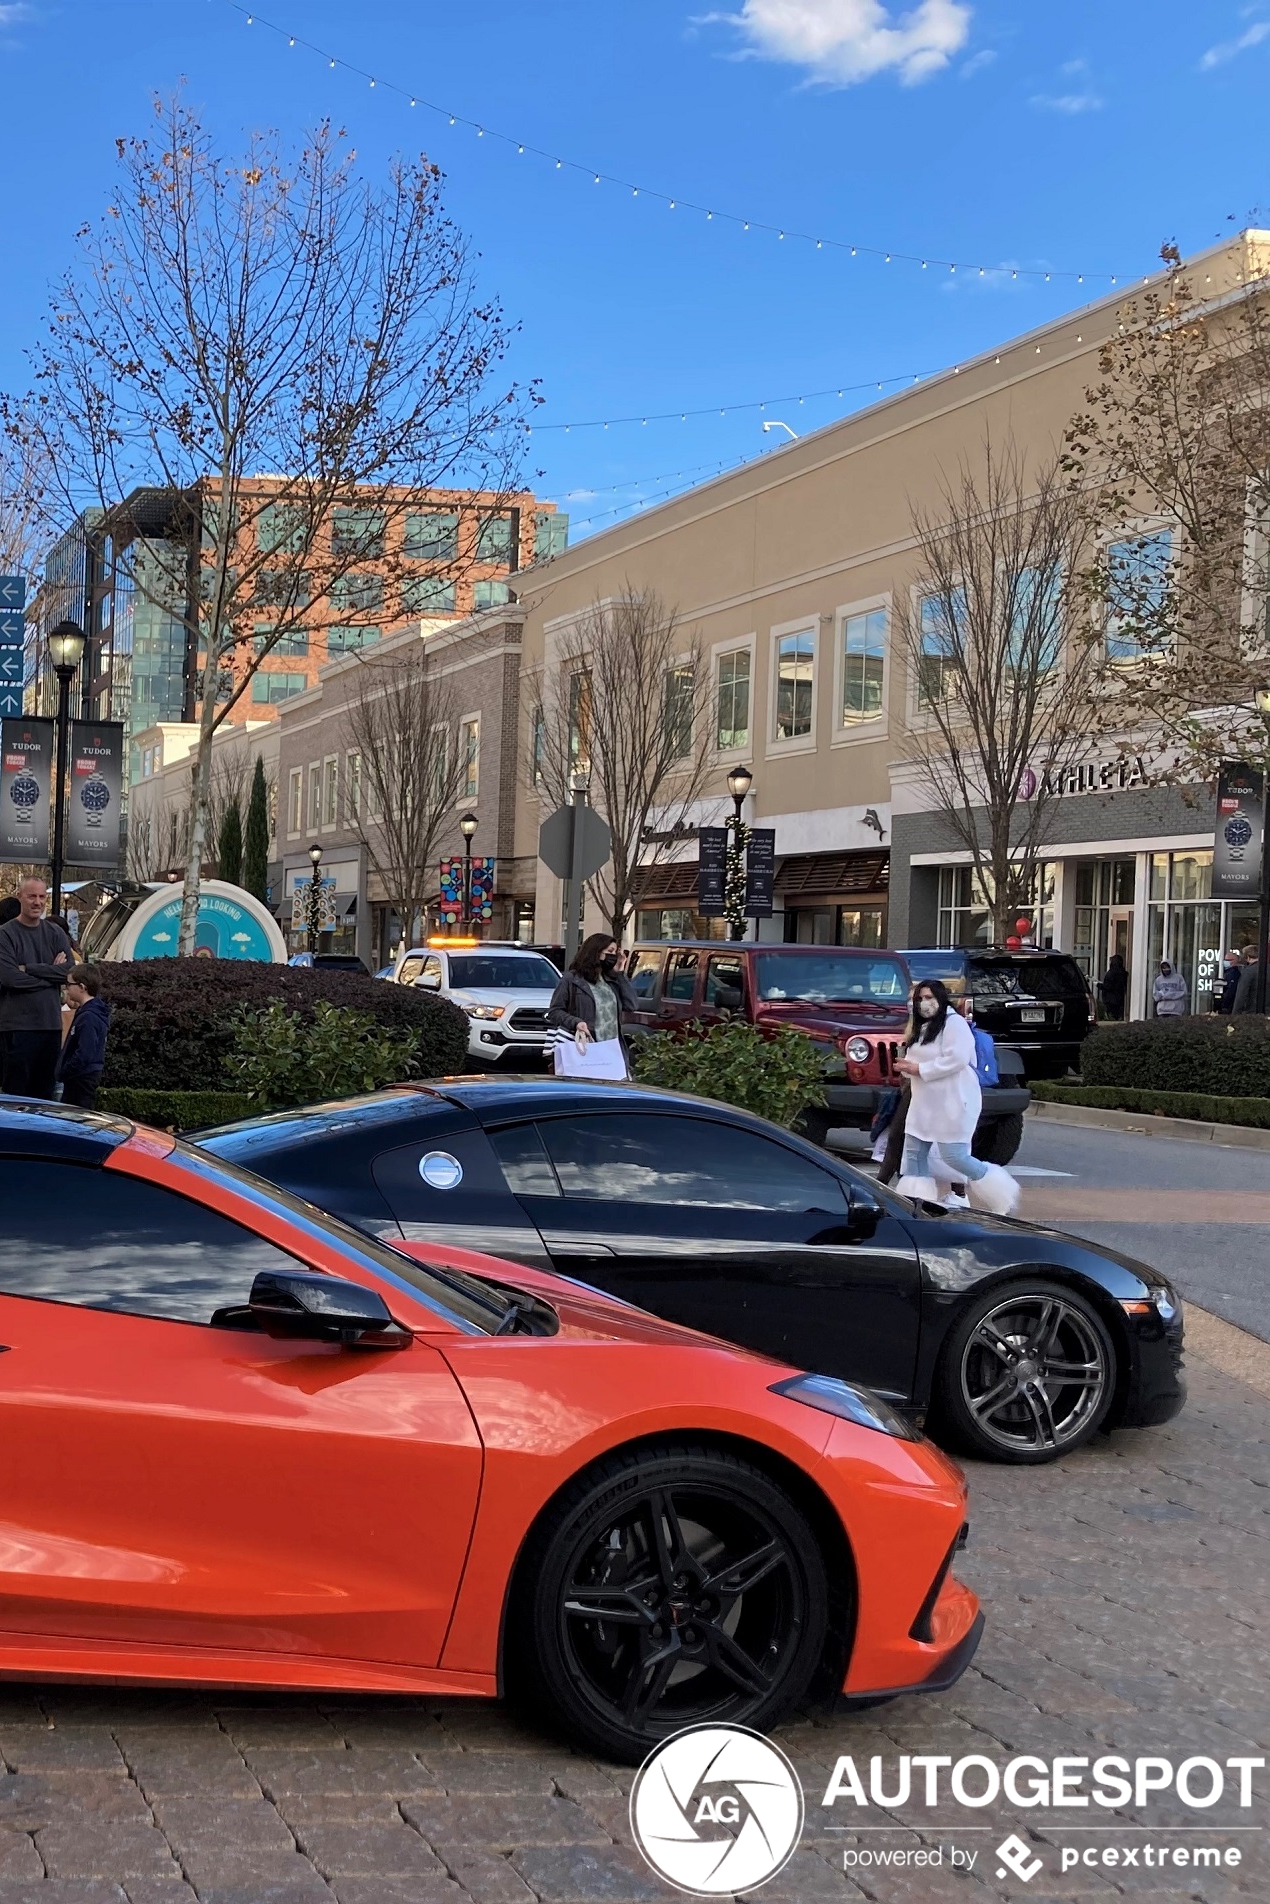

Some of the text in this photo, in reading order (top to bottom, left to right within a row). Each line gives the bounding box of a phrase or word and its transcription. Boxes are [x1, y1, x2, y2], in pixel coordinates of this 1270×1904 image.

[12, 743, 41, 751] TUDOR
[82, 747, 111, 756] TUDOR
[7, 836, 38, 844] MAYORS
[78, 840, 108, 848] MAYORS
[210, 899, 242, 922] LOOKING!
[1198, 964, 1214, 976] OF
